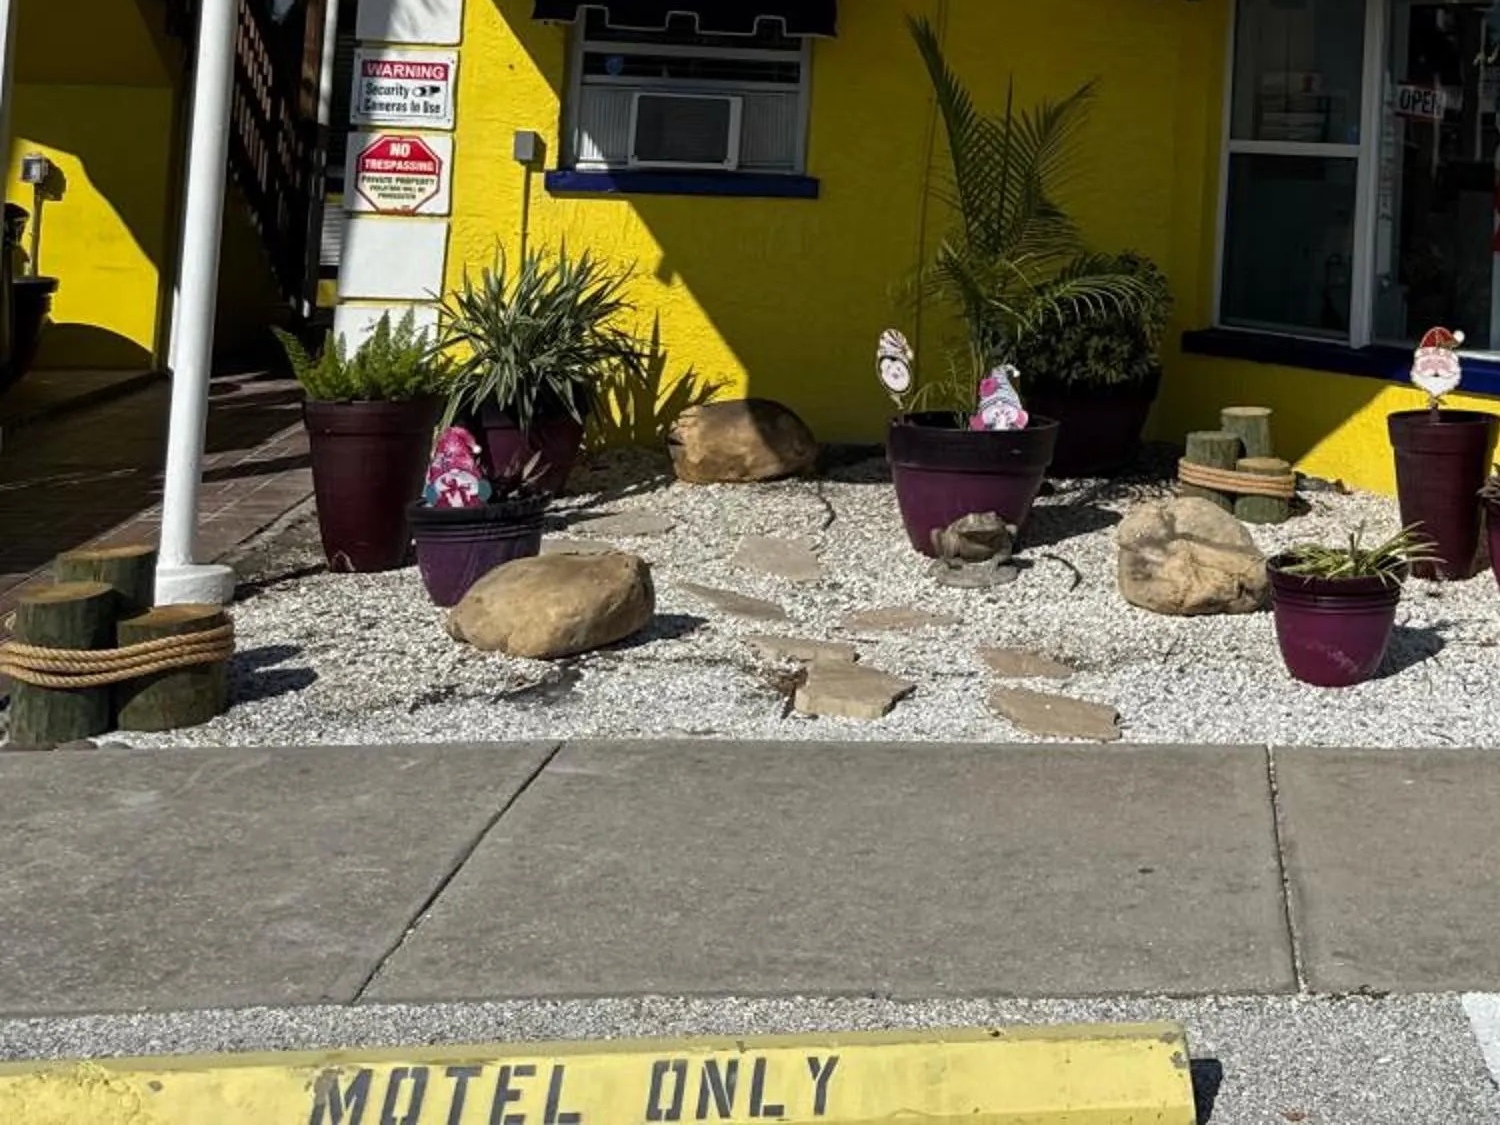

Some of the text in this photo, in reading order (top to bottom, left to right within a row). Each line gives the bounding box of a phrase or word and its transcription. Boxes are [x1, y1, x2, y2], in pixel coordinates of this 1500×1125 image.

[366, 62, 445, 79] WARNING
[365, 80, 410, 99] Security
[364, 98, 408, 113] Cameras
[389, 142, 411, 157] NO
[364, 158, 435, 172] TRESPASSING
[396, 176, 435, 186] PROPERTY
[308, 1054, 841, 1125] MOTEL ONLY
